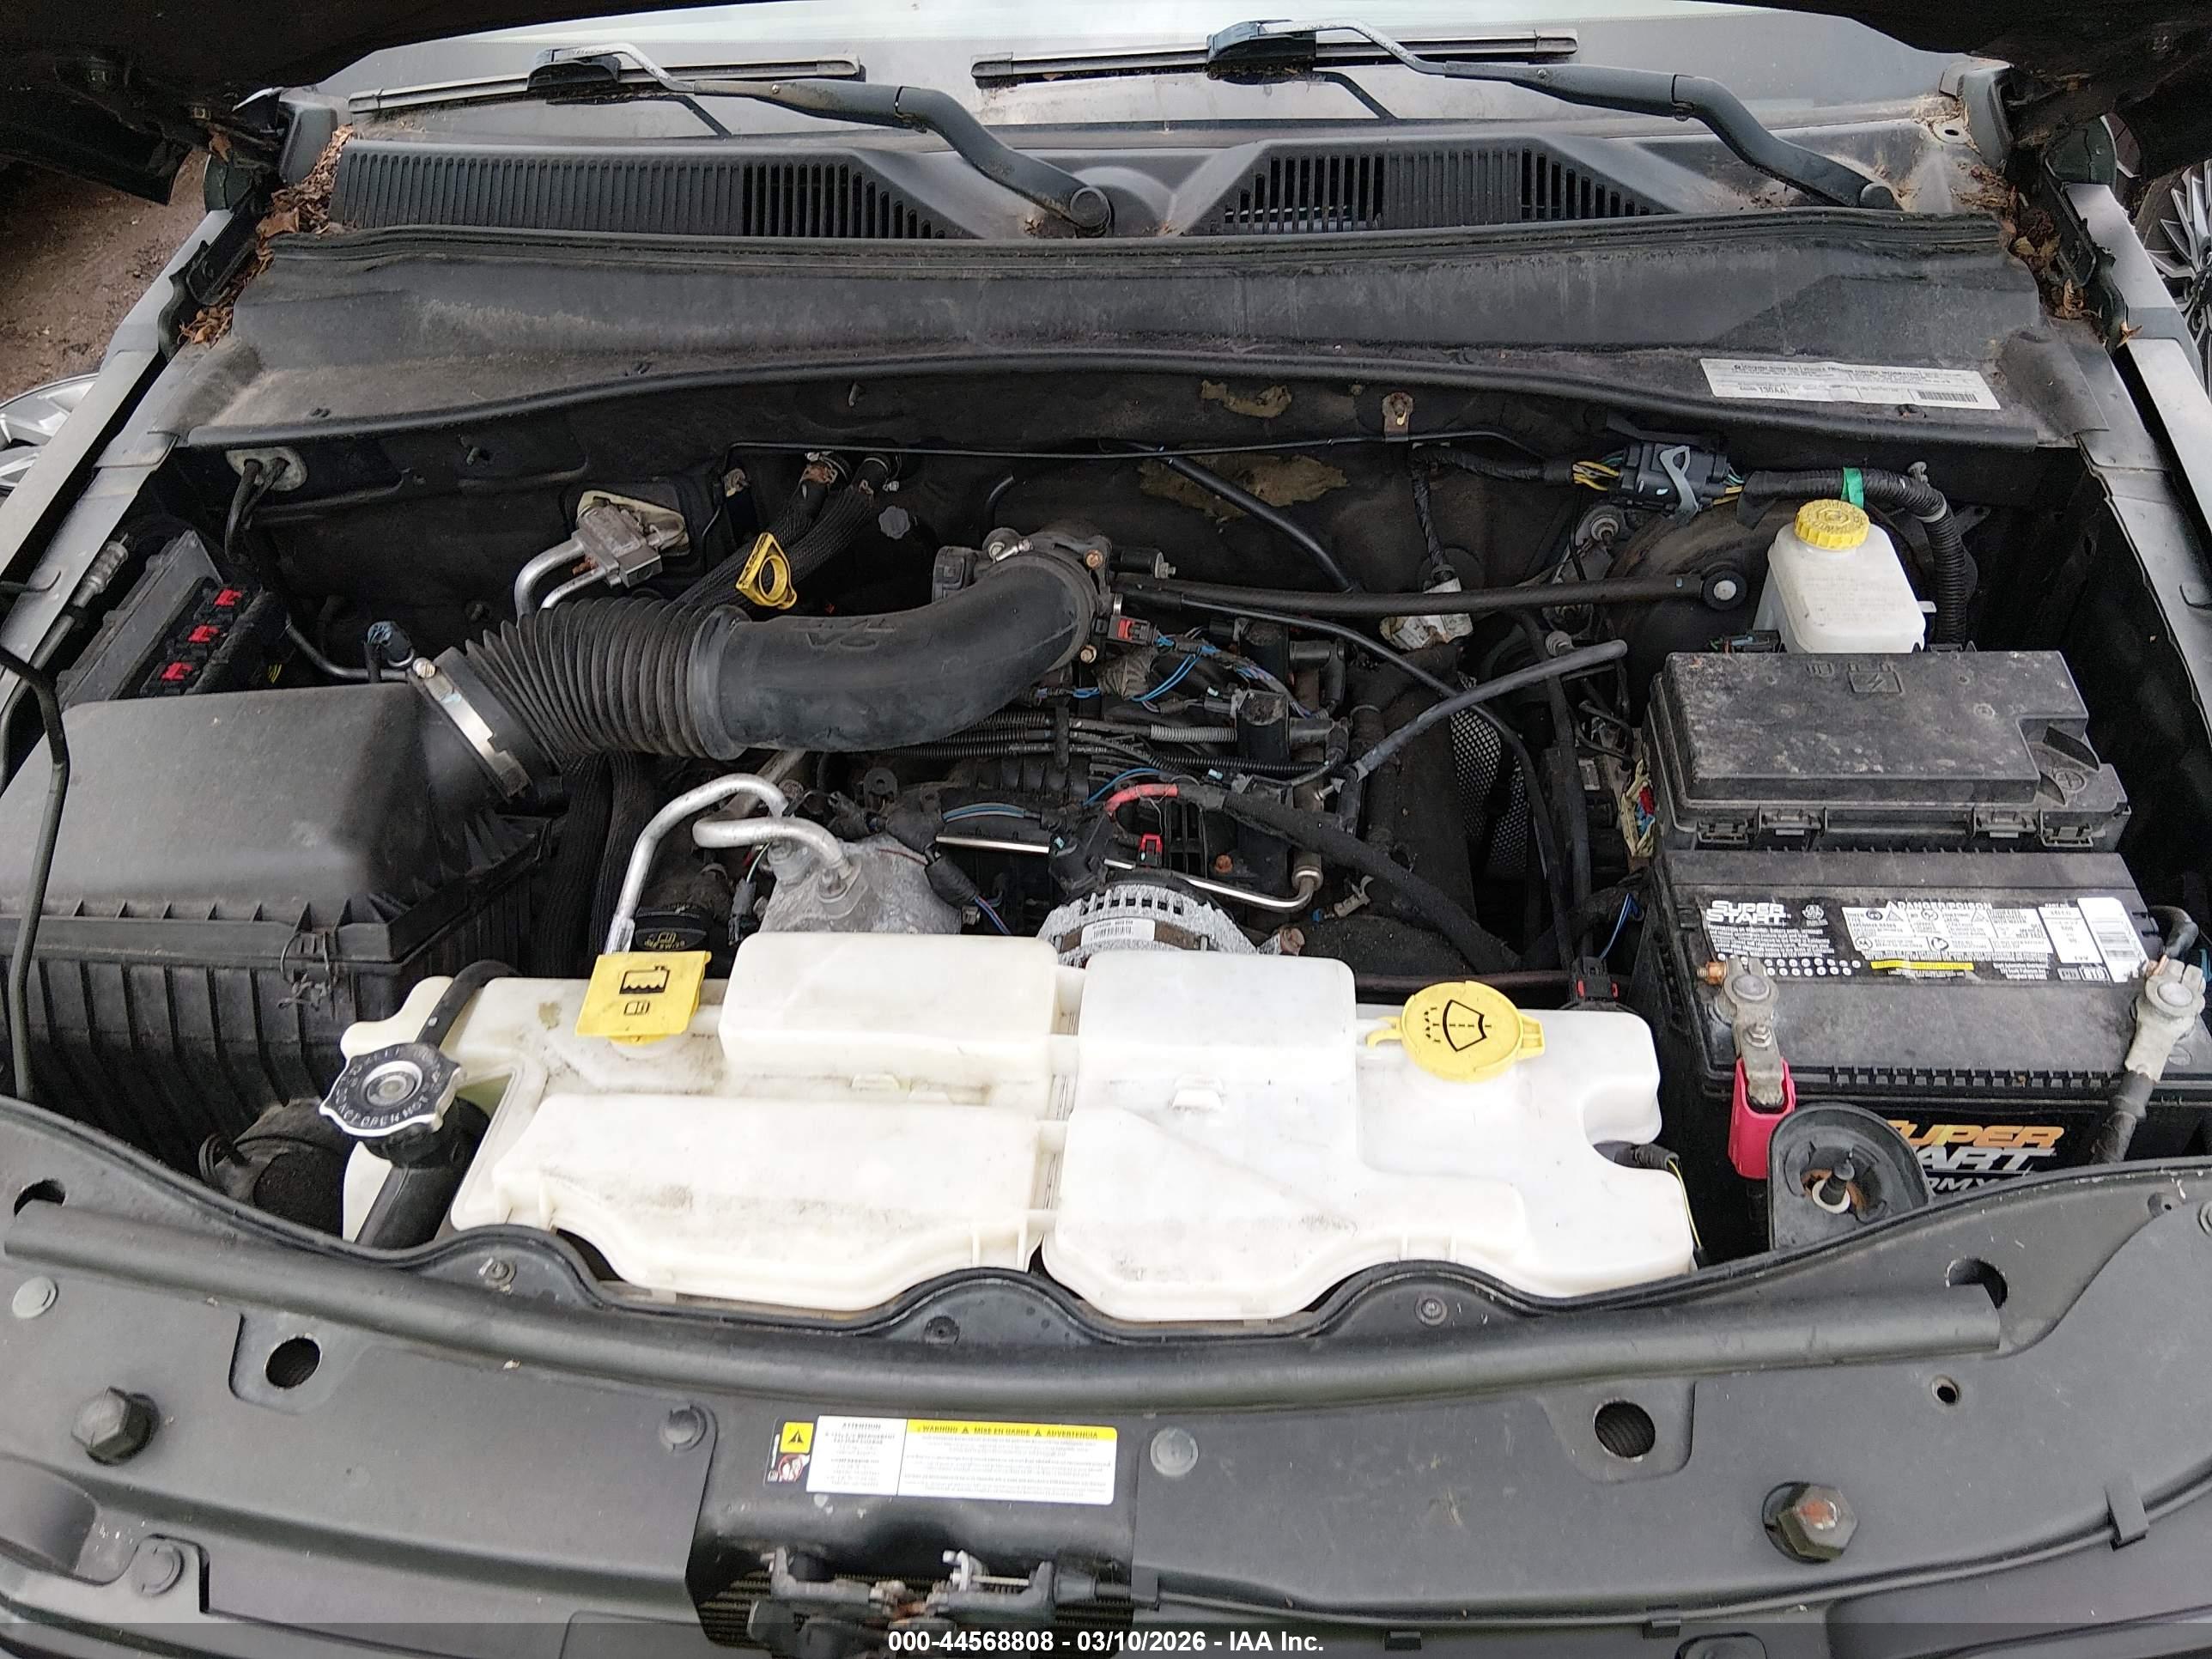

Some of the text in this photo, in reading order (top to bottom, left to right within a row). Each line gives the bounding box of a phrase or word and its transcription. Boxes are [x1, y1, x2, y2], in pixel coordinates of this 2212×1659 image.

[1711, 900, 1785, 914] SUPER
[1705, 908, 1786, 925] START
[1913, 1146, 2057, 1171] ART
[922, 1425, 958, 1434] WARNING
[1046, 1429, 1098, 1439] ADVERTENCIA
